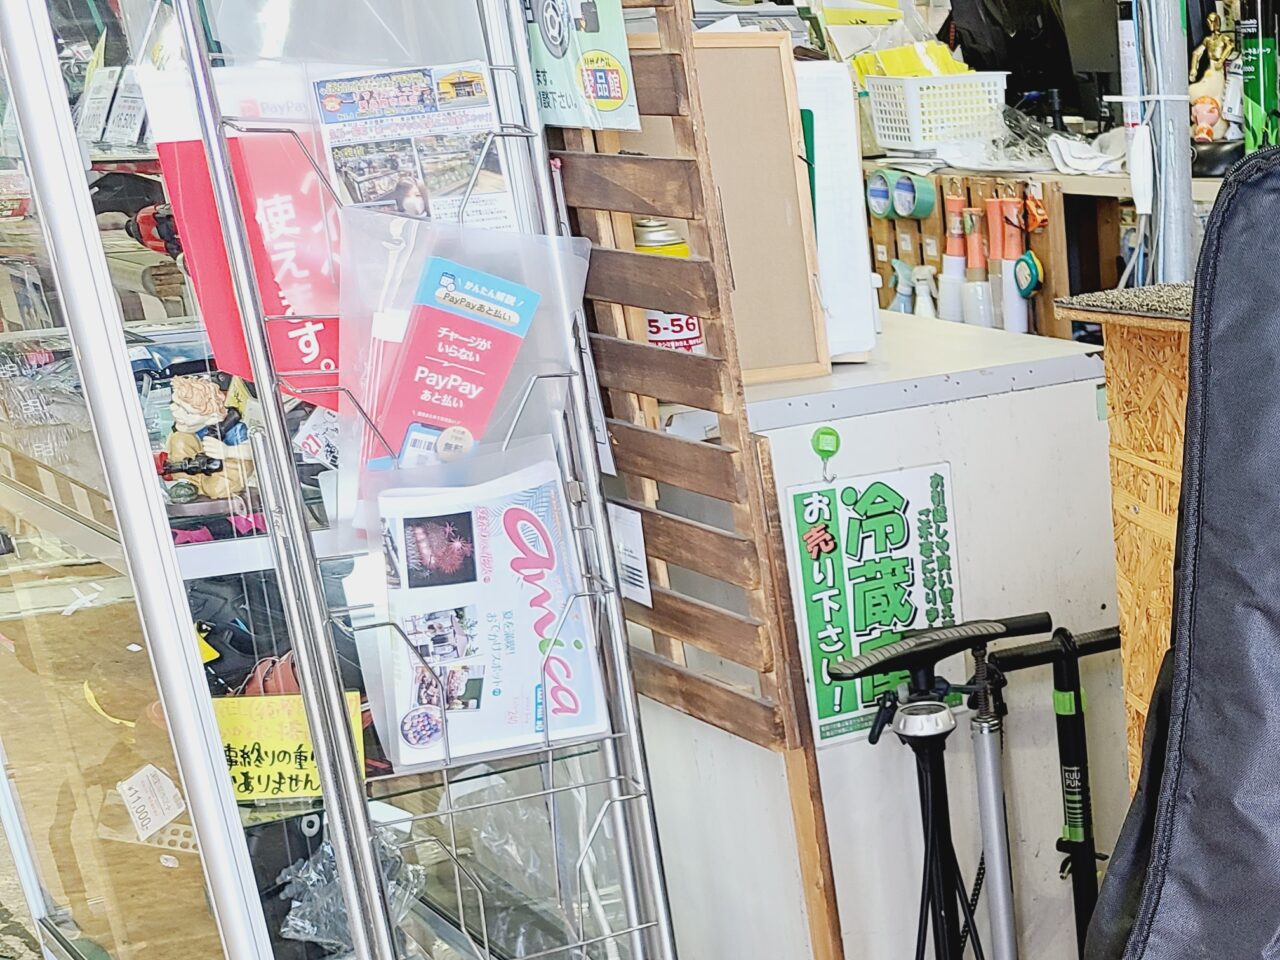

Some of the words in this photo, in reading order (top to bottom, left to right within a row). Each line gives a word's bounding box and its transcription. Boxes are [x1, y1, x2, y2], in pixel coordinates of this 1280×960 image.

[582, 70, 622, 99] 愛品館
[648, 315, 696, 335] 5-56
[437, 326, 492, 351] チャージが
[437, 342, 480, 363] いらない
[414, 366, 485, 399] PayPay
[420, 390, 464, 409] あと払い
